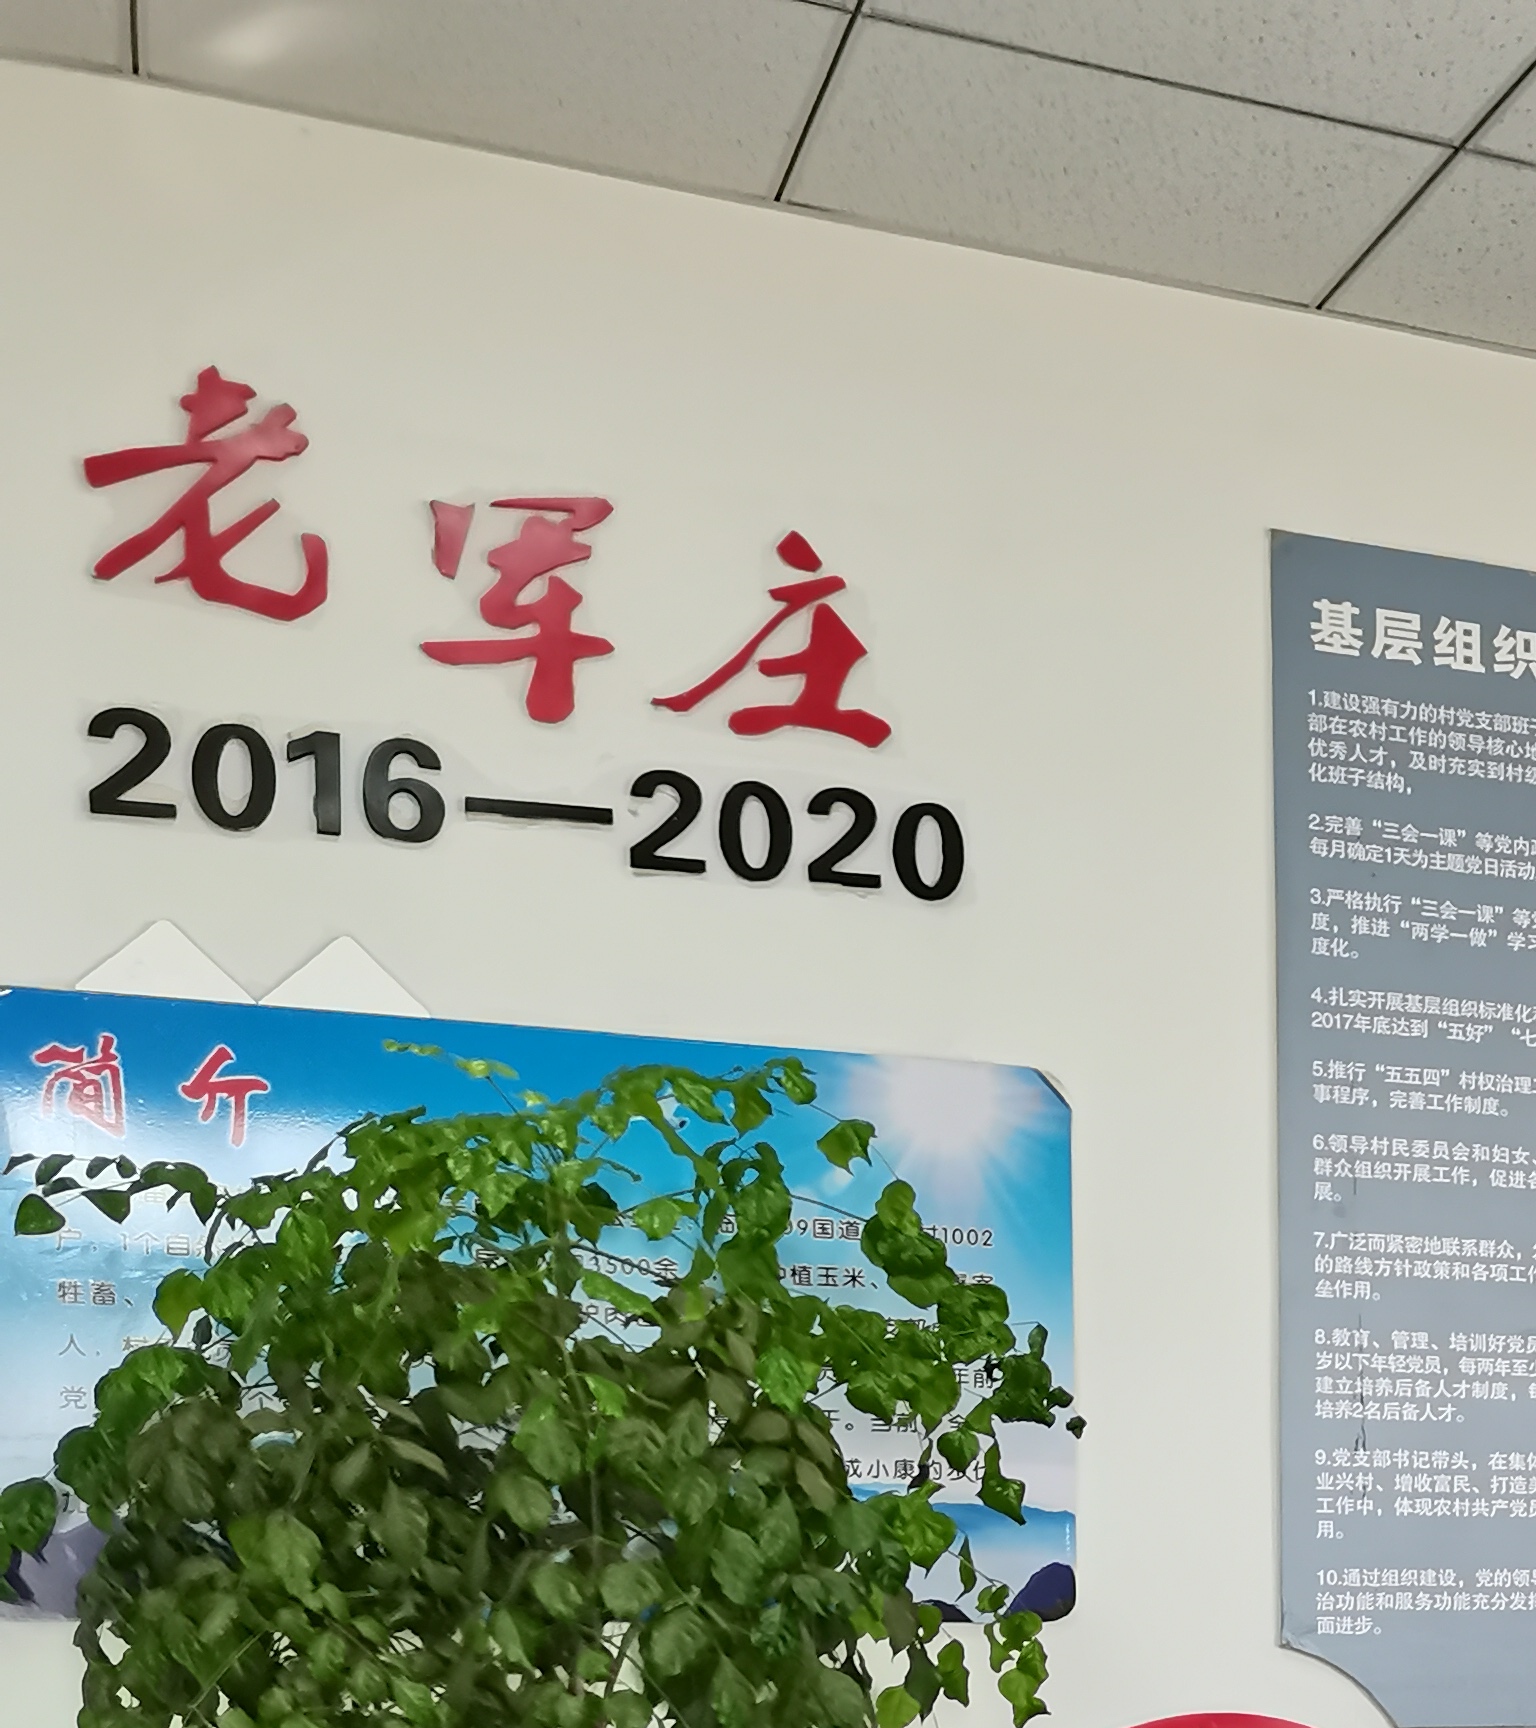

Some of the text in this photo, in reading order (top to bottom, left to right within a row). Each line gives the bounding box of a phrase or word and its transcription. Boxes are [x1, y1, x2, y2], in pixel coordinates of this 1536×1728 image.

[83, 364, 893, 748] 老军庄
[31, 1032, 271, 1150] 简介
[779, 1264, 878, 1290] 植玉米、
